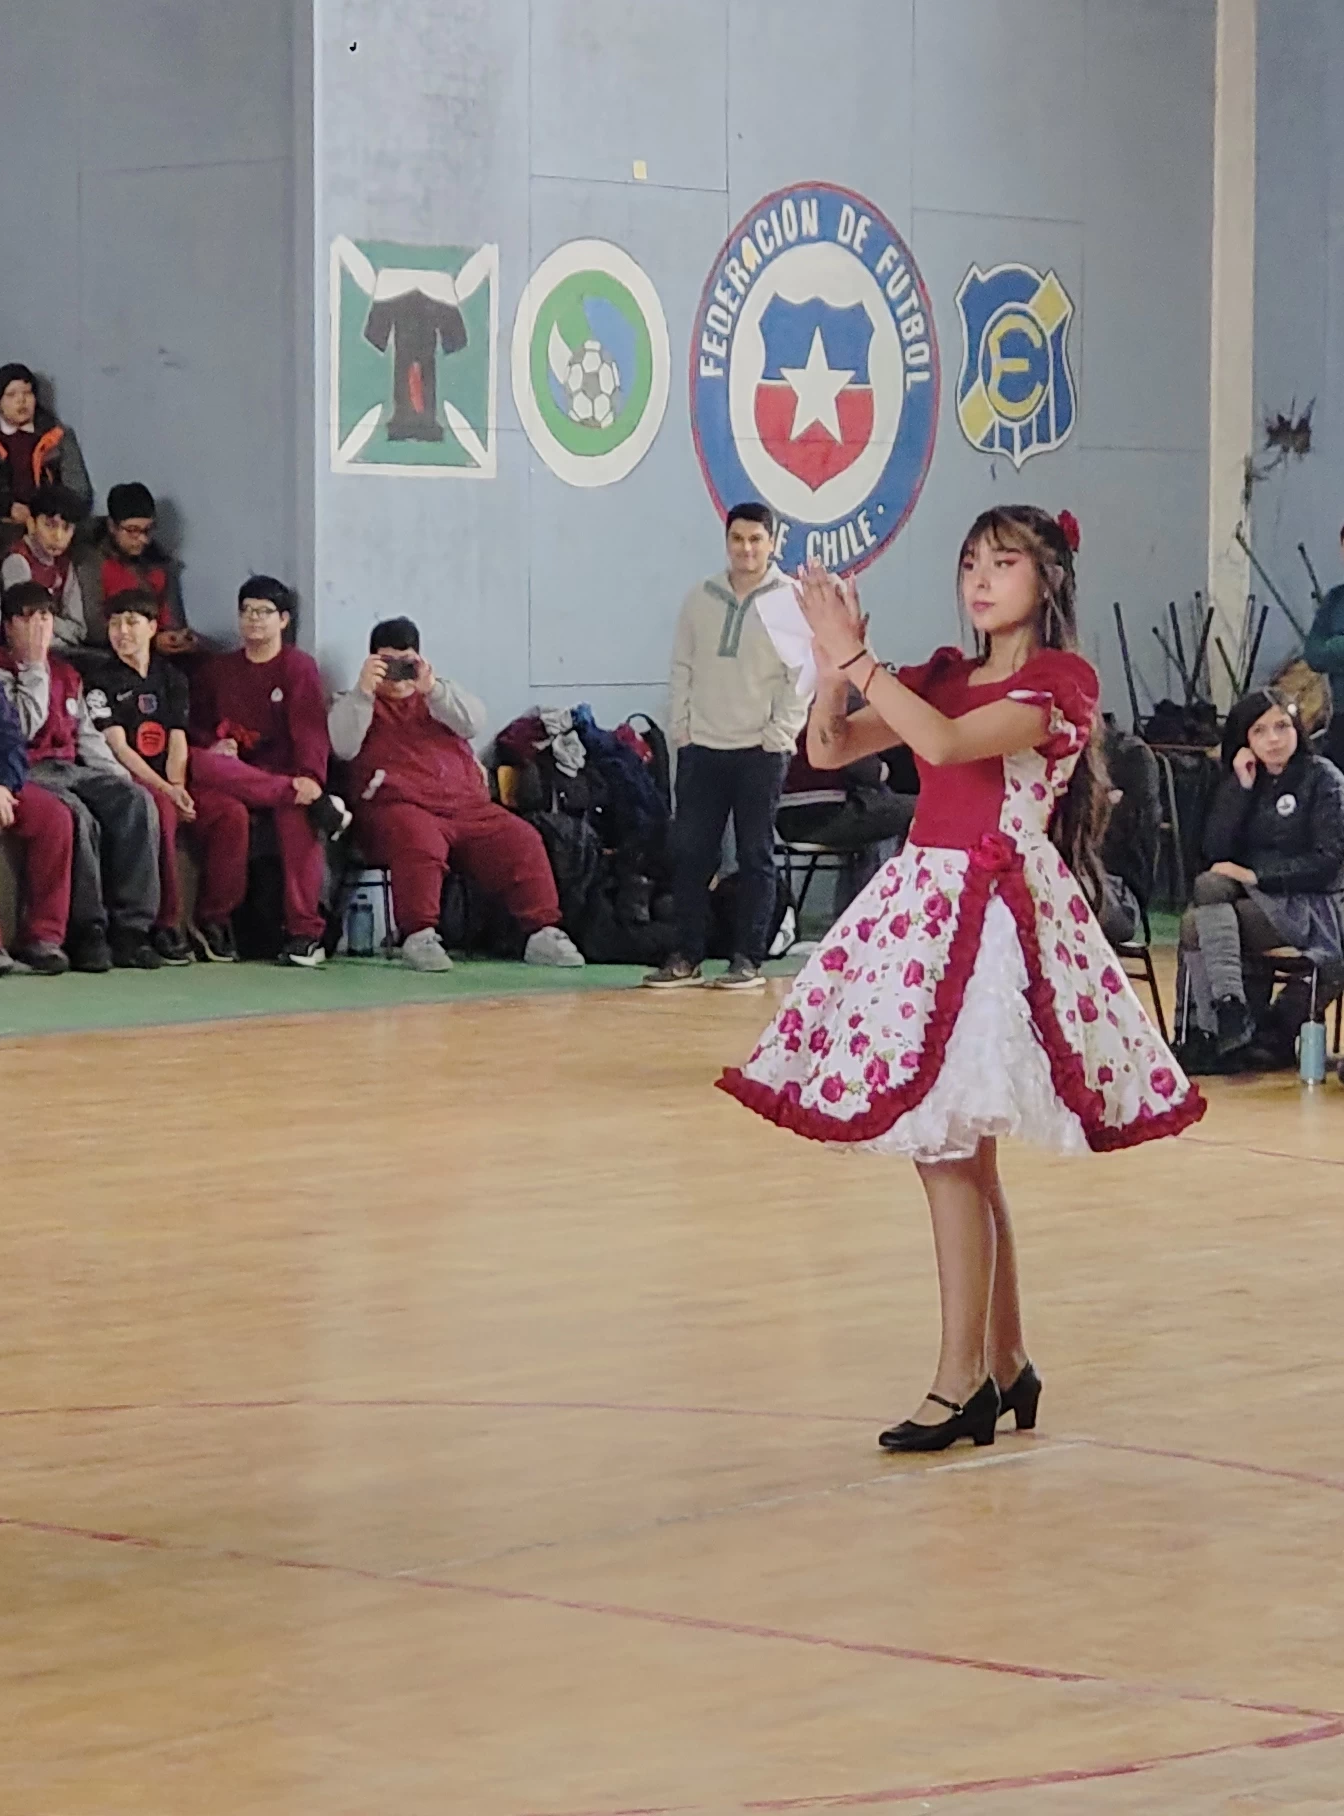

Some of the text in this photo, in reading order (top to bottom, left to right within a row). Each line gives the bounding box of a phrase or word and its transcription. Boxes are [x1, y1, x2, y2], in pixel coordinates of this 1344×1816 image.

[699, 198, 931, 392] FEDERACION DE FUTBOL
[806, 508, 877, 568] CHILE
